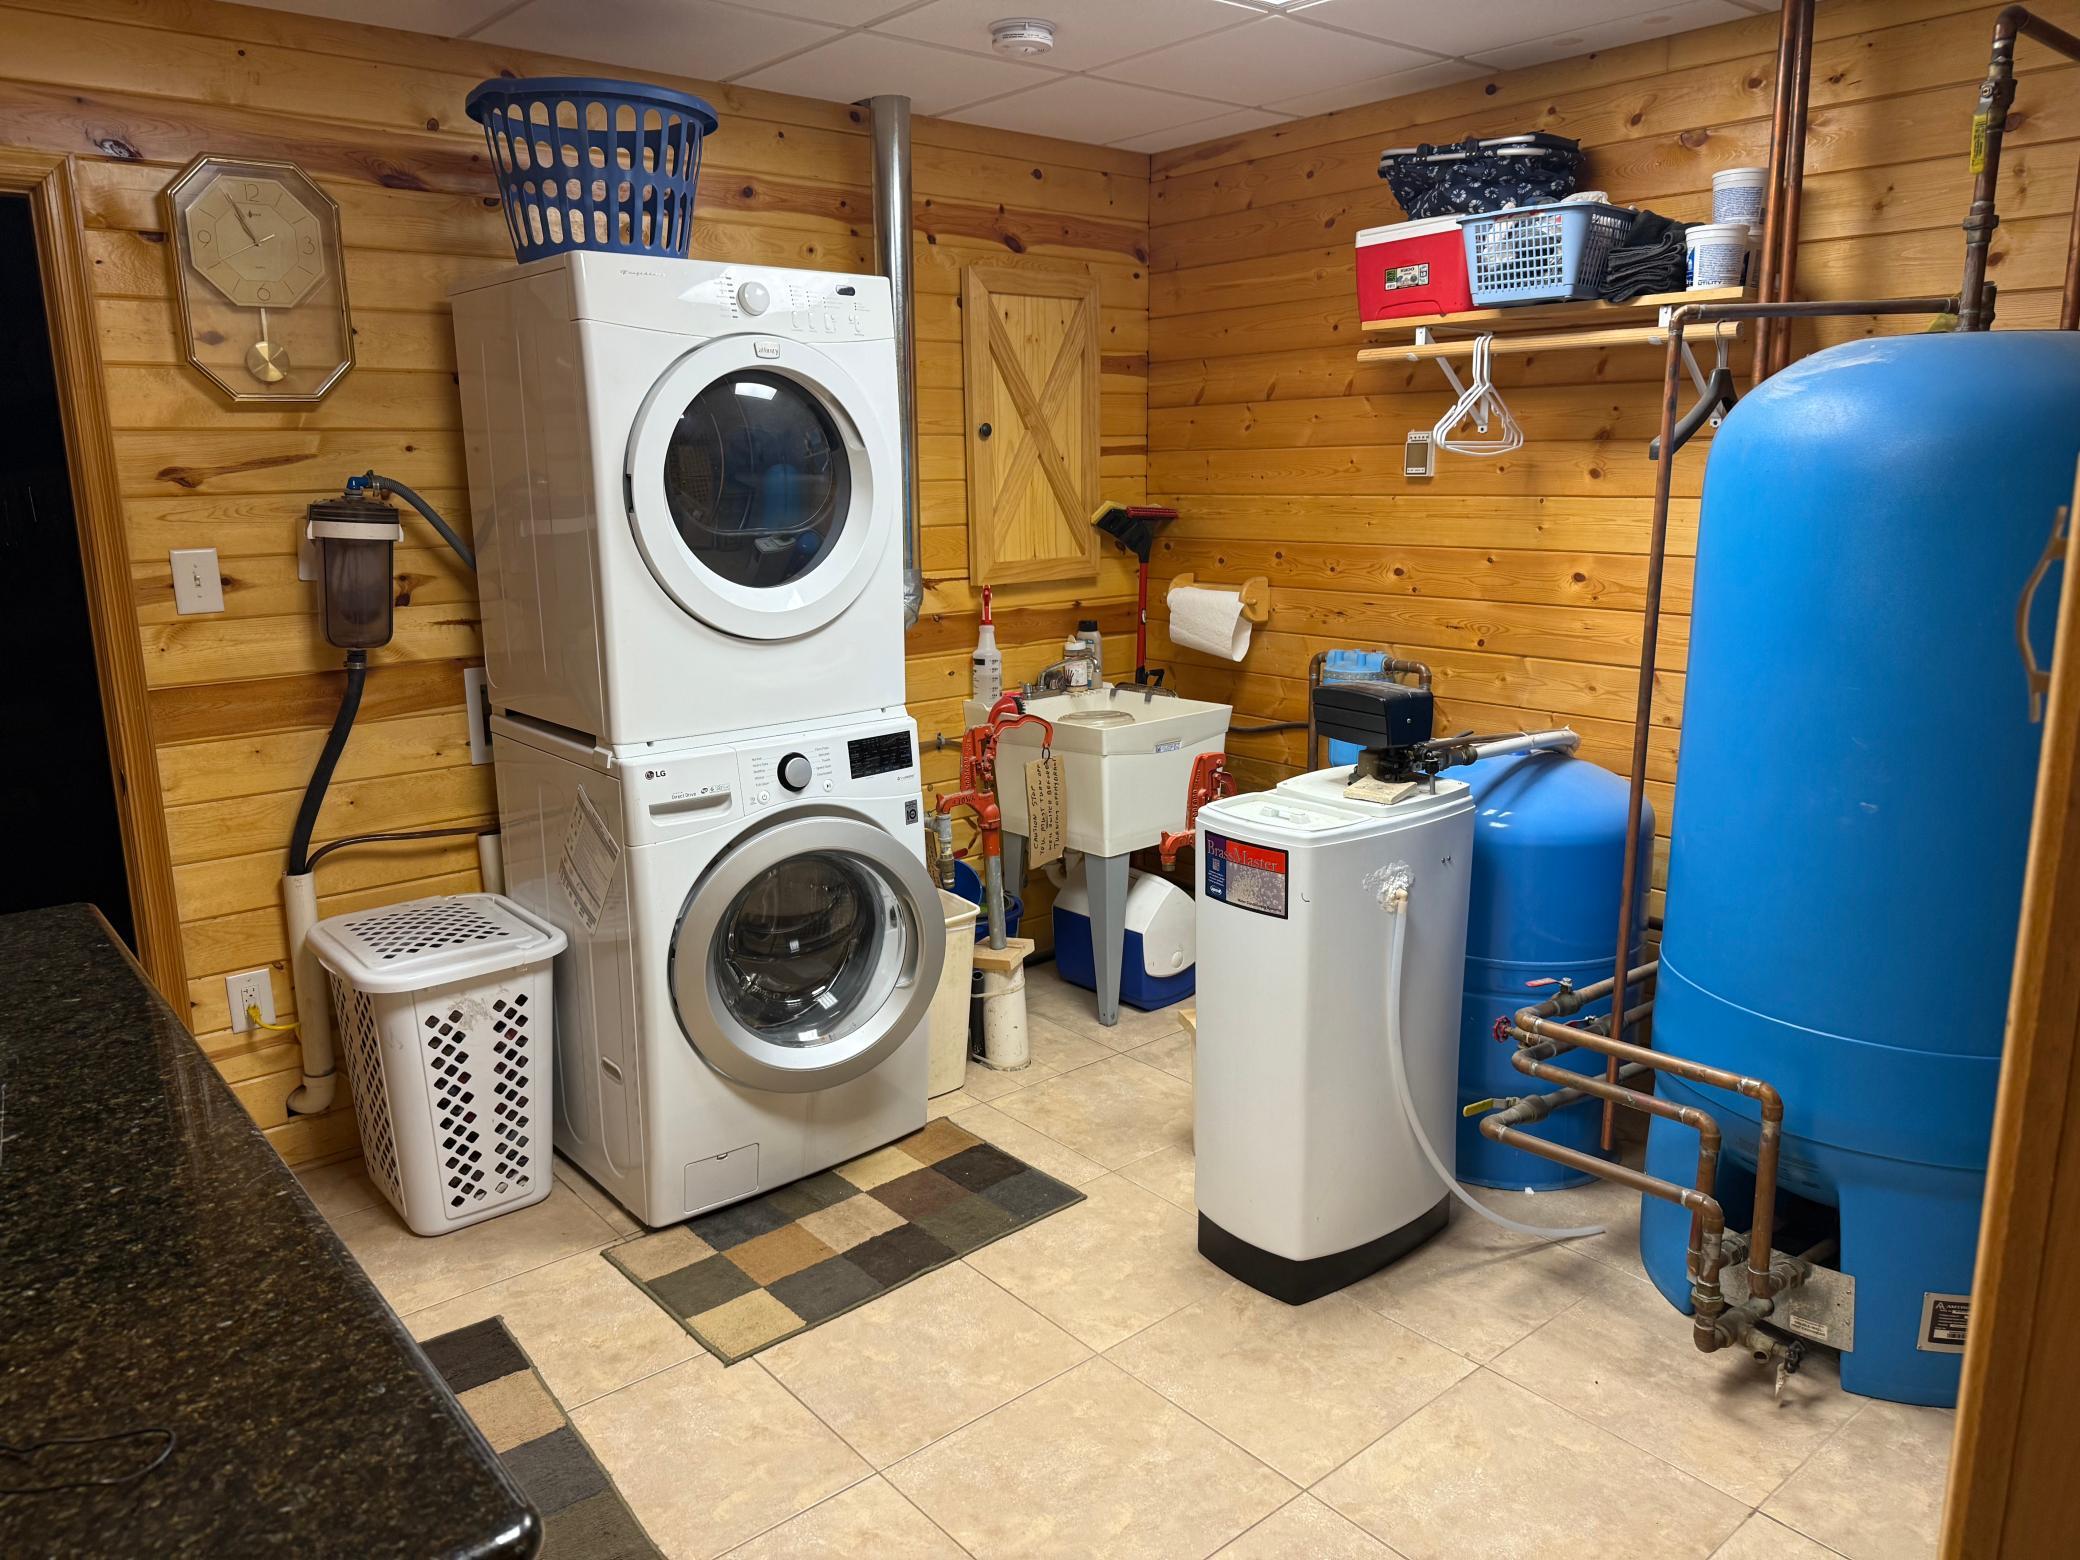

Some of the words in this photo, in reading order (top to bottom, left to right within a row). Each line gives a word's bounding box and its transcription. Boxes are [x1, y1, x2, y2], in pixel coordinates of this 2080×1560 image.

[243, 183, 260, 202] 12
[197, 229, 212, 248] 9
[302, 235, 316, 255] 3
[256, 282, 271, 301] 6
[655, 770, 667, 778] LG
[1206, 839, 1279, 872] BrassMaster
